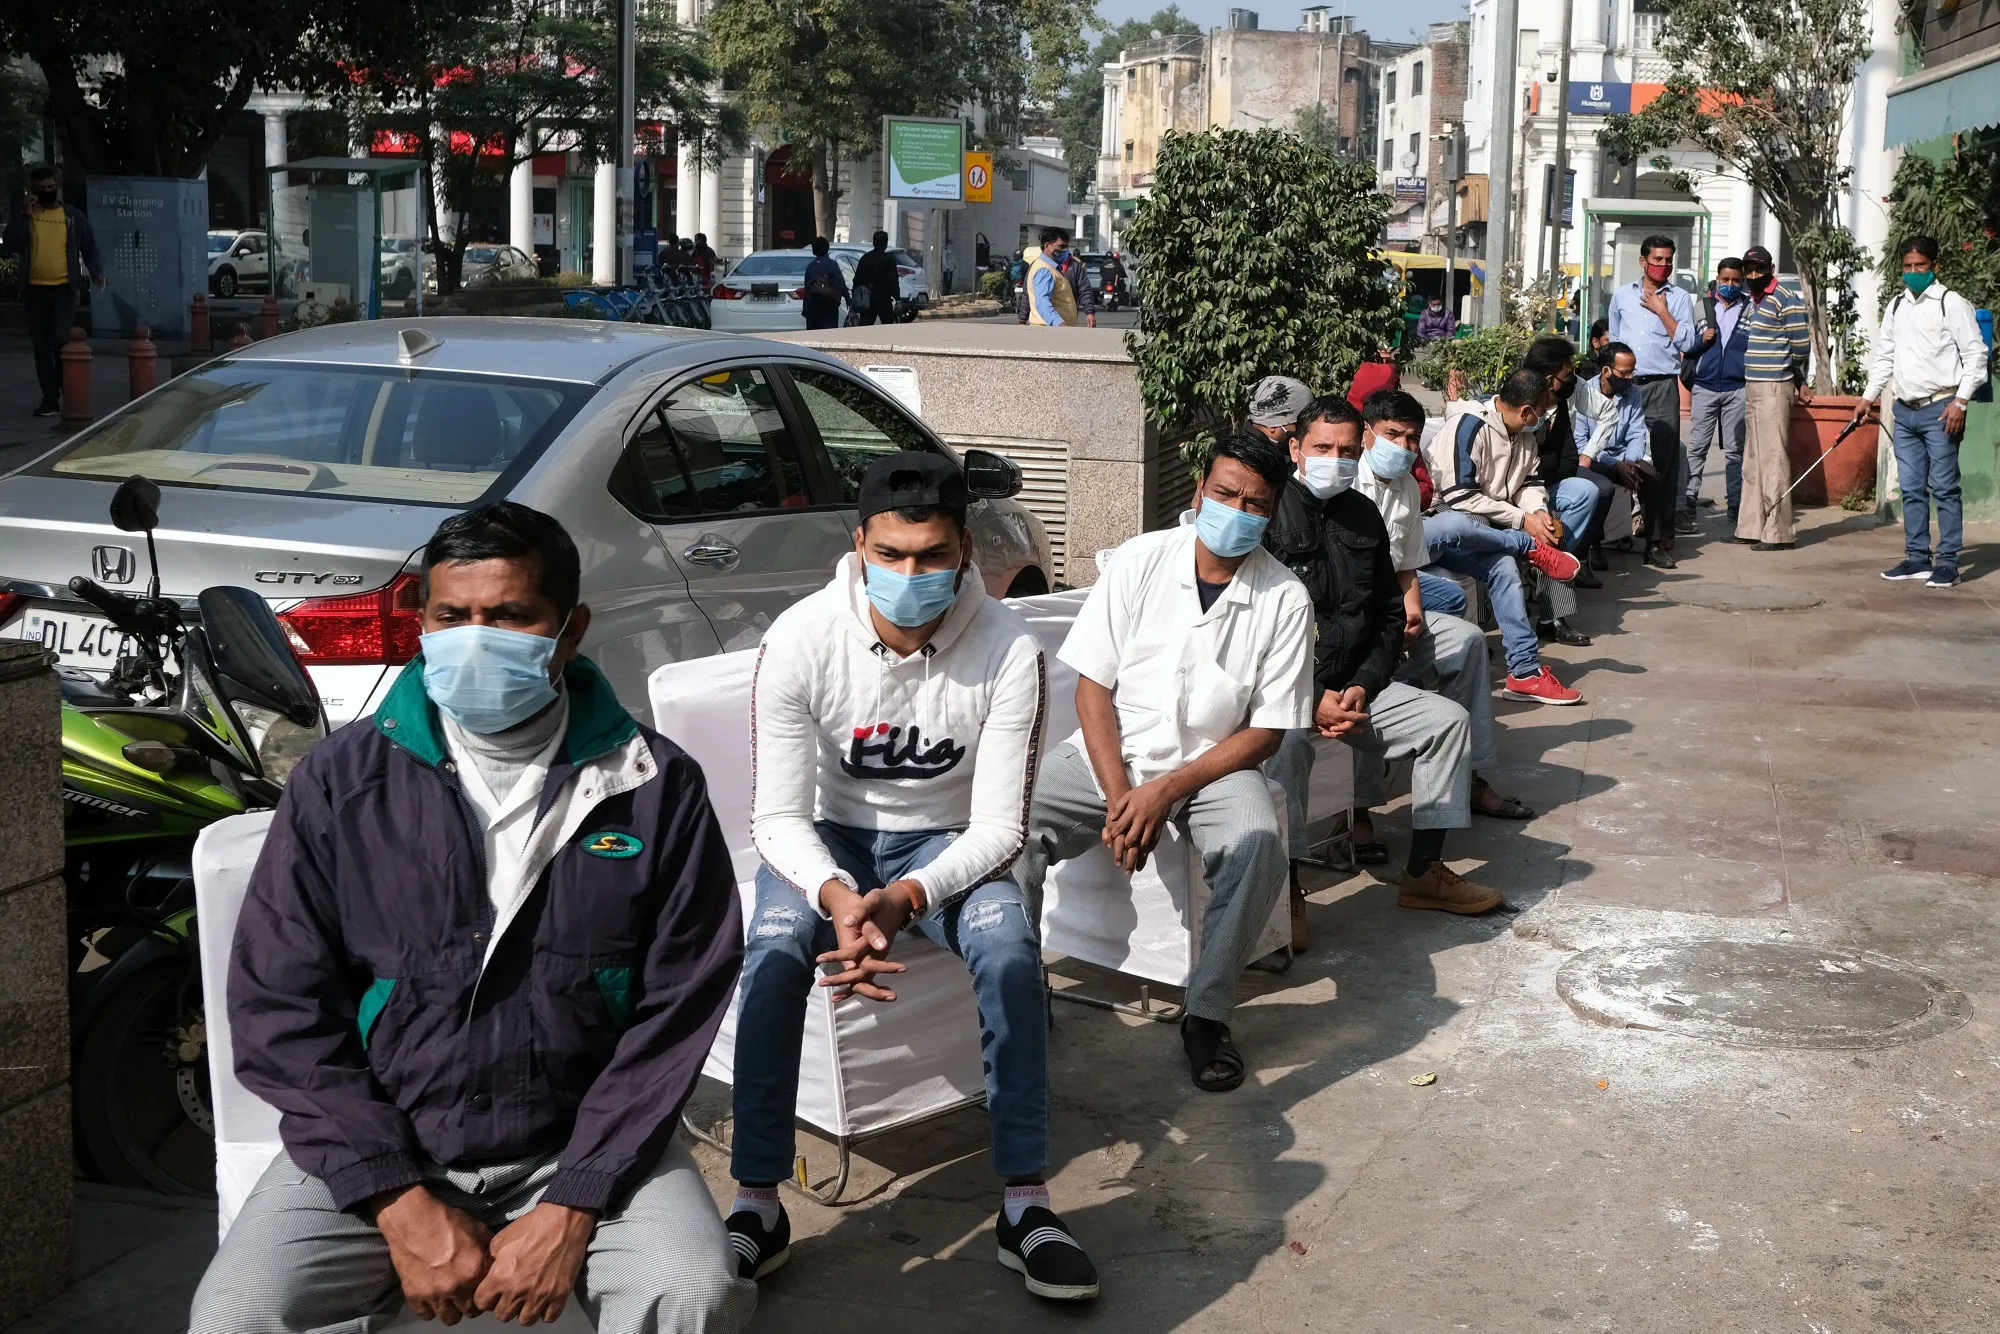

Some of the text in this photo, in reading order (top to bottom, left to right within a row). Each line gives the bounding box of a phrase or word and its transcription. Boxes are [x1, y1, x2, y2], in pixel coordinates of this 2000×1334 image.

[1397, 177, 1426, 187] Vedi's
[102, 196, 164, 207] EV Charging
[116, 208, 153, 218] Station
[254, 570, 333, 585] CITY
[26, 630, 42, 641] IND
[843, 722, 966, 778] Fila
